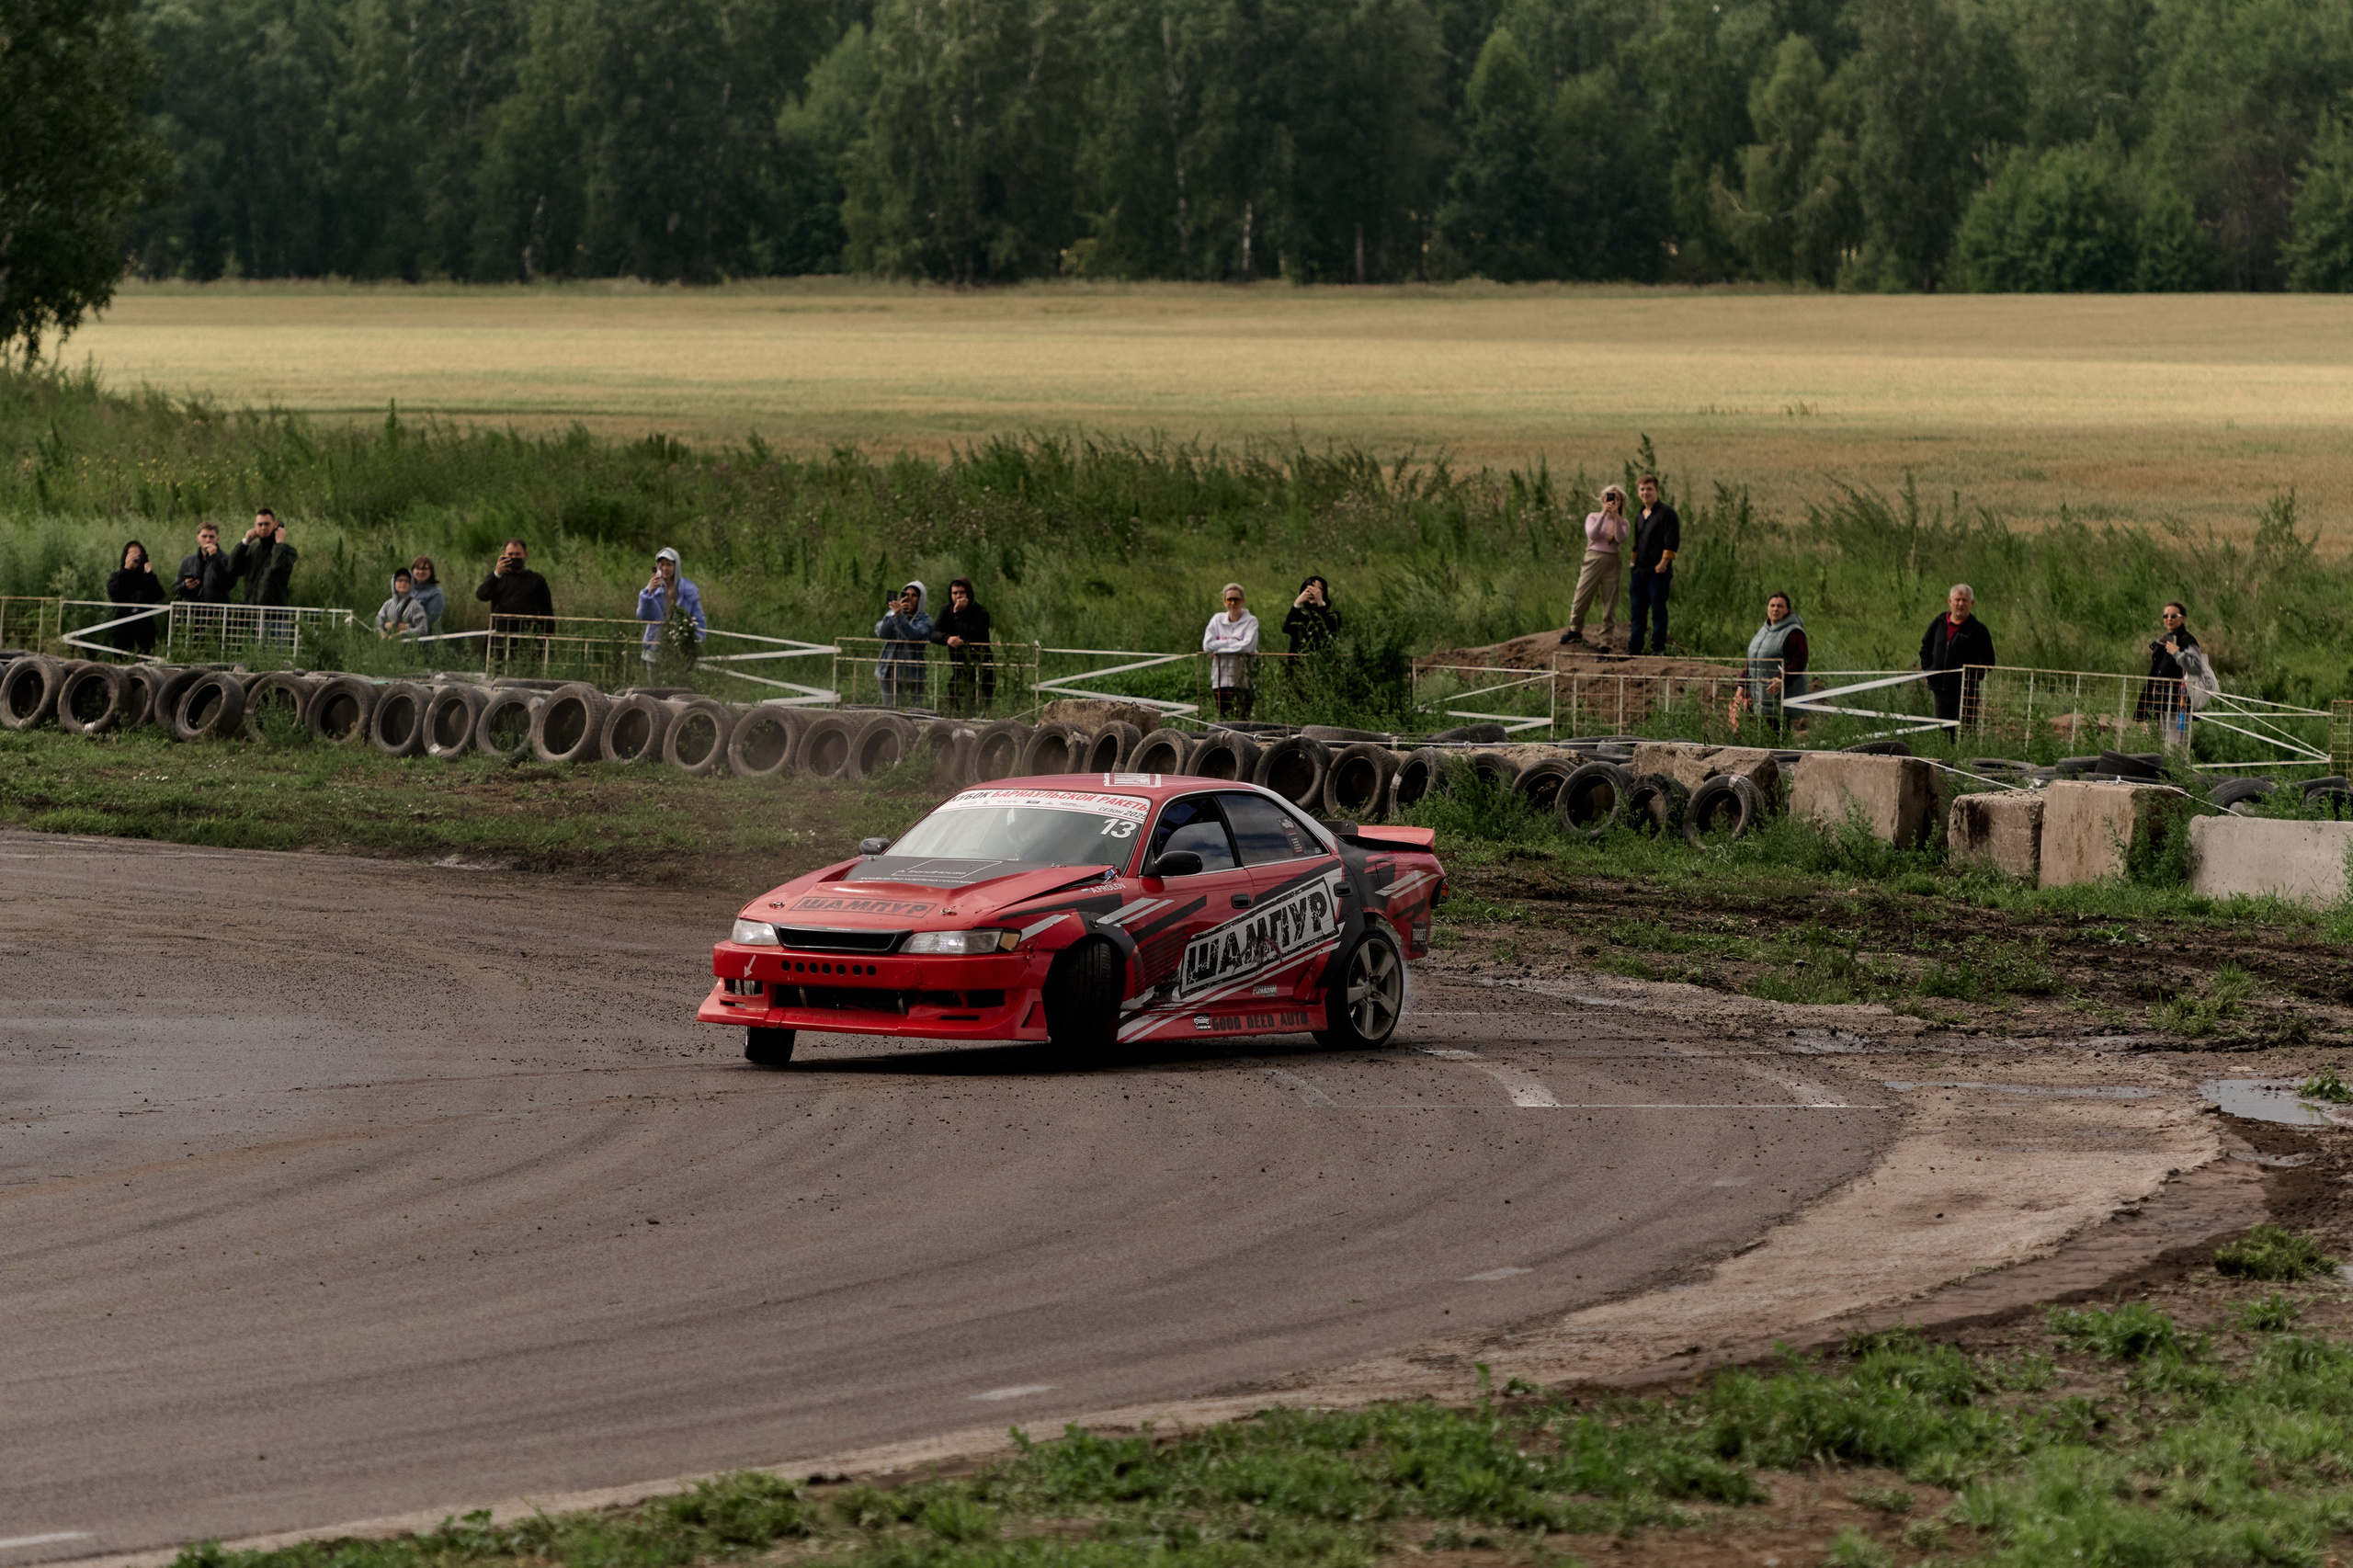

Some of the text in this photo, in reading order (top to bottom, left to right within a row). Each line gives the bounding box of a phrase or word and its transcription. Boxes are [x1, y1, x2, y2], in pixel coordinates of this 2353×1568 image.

[949, 791, 993, 803] КУБОК
[991, 790, 1097, 801] БАРНАУЛЬСКОЙ
[1098, 806, 1122, 814] СЕЗОН
[1100, 818, 1137, 838] 13
[798, 898, 929, 915] ШАМПУР
[1186, 891, 1328, 986] ШАМПУР
[1211, 1011, 1308, 1031] GOOD DEED AUTO
